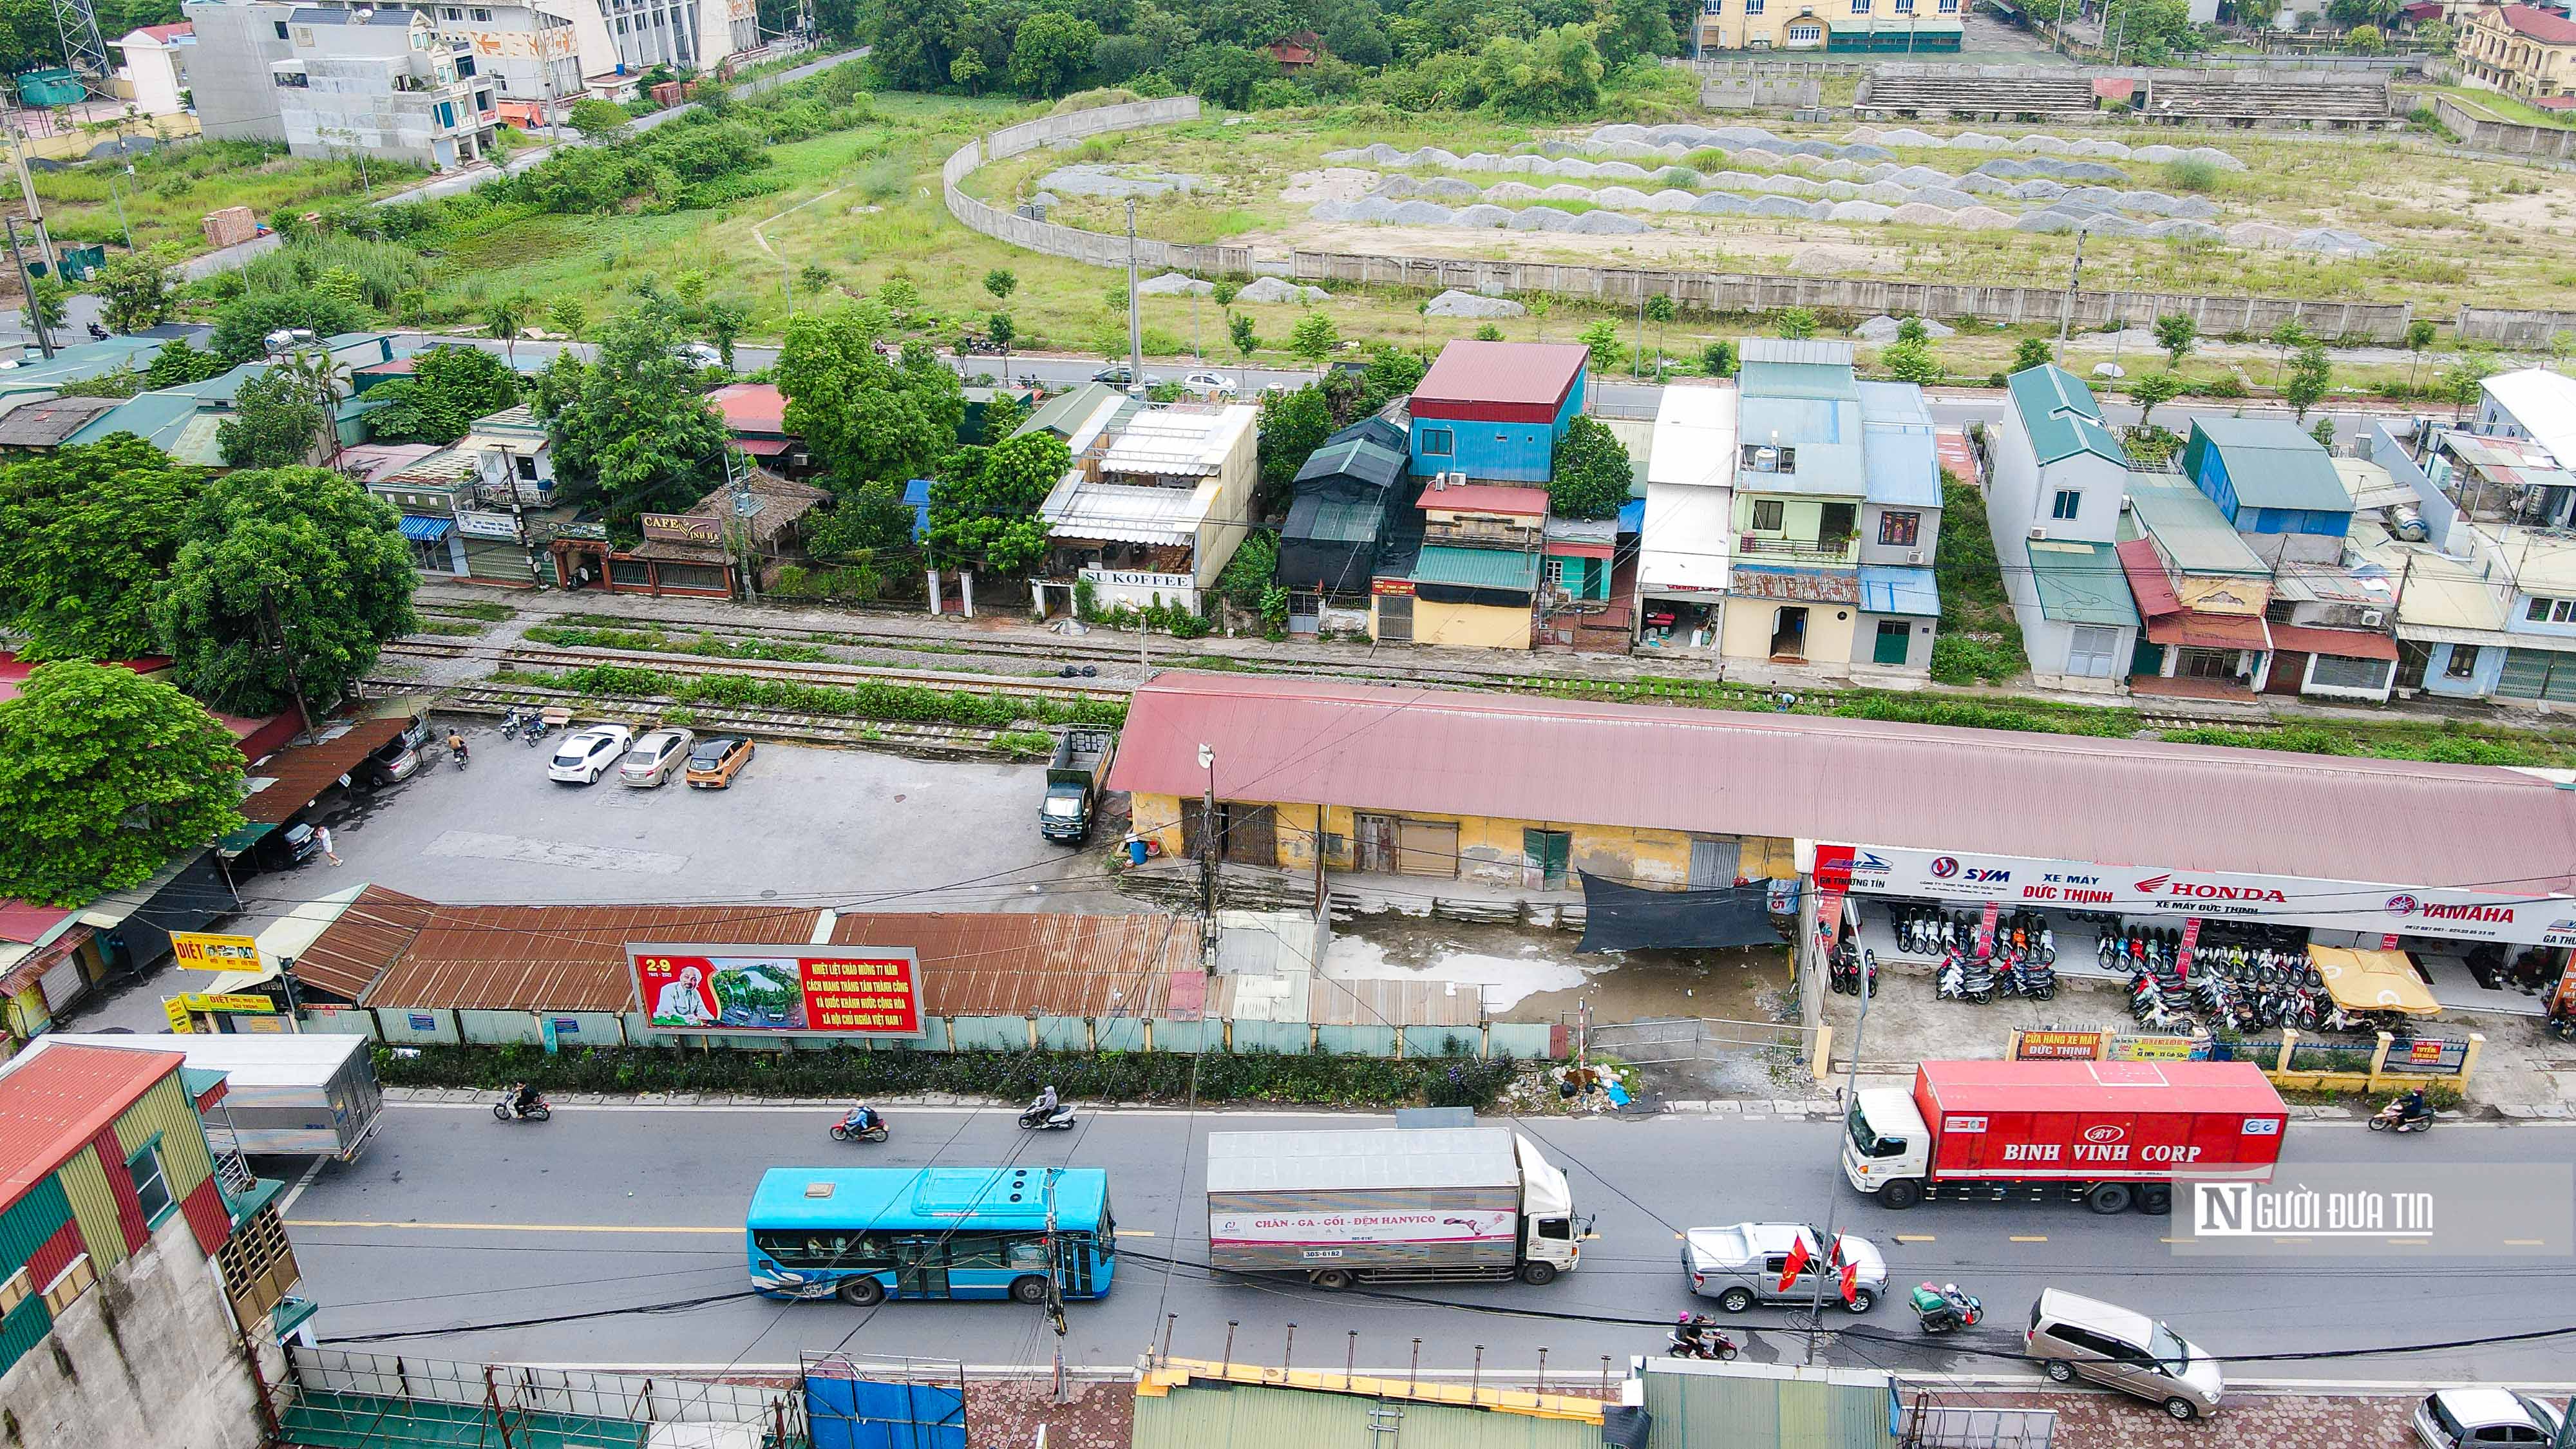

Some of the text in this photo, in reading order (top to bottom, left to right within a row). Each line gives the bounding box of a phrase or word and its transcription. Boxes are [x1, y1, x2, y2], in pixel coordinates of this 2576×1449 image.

[644, 517, 679, 528] CAFE
[1086, 572, 1188, 587] SU KOFFEE
[1833, 876, 1868, 887] THƯỜNG
[1871, 878, 1885, 888] TÍN
[1963, 868, 2011, 882] SYM
[2043, 873, 2099, 885] XE MÁY
[2023, 884, 2114, 904] ĐỨC THỊNH
[2170, 883, 2287, 903] HONDA
[2172, 902, 2196, 910] MÁY
[2198, 903, 2222, 913] ĐỨC
[2224, 906, 2259, 915] THỊNH
[2423, 903, 2515, 923] YAMAHA
[2543, 934, 2557, 943] GA
[176, 940, 203, 961] DIỆT
[646, 959, 671, 972] 2-9
[812, 962, 898, 977] NHIỆT LIỆT CHÀO MỪNG 77 NĂM
[806, 979, 909, 994] CÁCH MẠNG THÁNG TÁM THÀNH CÔNG
[209, 994, 229, 1003] DIỆT
[816, 994, 906, 1011] VÀ QUỐC KHÁNH NƯỚC CỘNG HÒA
[822, 1012, 832, 1025] XÃ
[832, 1012, 841, 1027] HỘI
[842, 1010, 854, 1025] CHỦ
[854, 1012, 872, 1025] NGHĨA
[872, 1013, 884, 1028] VIỆT
[885, 1015, 899, 1026] NAM
[2025, 1032, 2098, 1045] CỬA HÀNG XE MÁY
[2029, 1045, 2091, 1056] ĐỨC THỊNH
[2003, 1144, 2201, 1163] BINH VINH CORP
[1255, 1218, 1288, 1227] CHĂN
[1323, 1215, 1344, 1226] GỐI
[1354, 1216, 1378, 1227] ĐỆM
[1381, 1215, 1435, 1224] HANVICO
